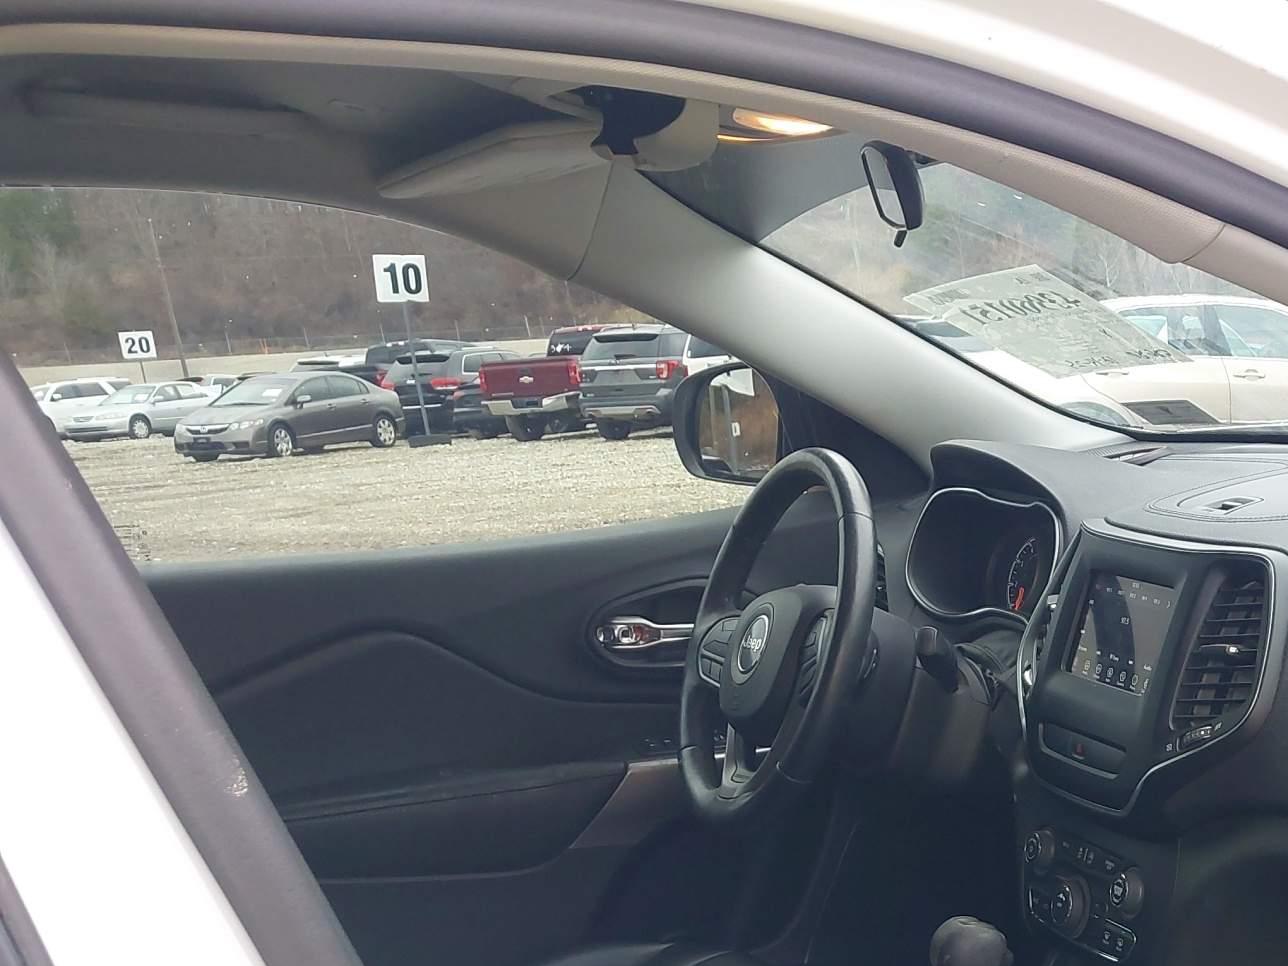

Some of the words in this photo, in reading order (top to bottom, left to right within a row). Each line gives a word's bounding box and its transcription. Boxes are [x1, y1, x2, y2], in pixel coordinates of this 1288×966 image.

[383, 262, 422, 295] 10
[124, 336, 151, 354] 20
[744, 635, 762, 652] Jeep
